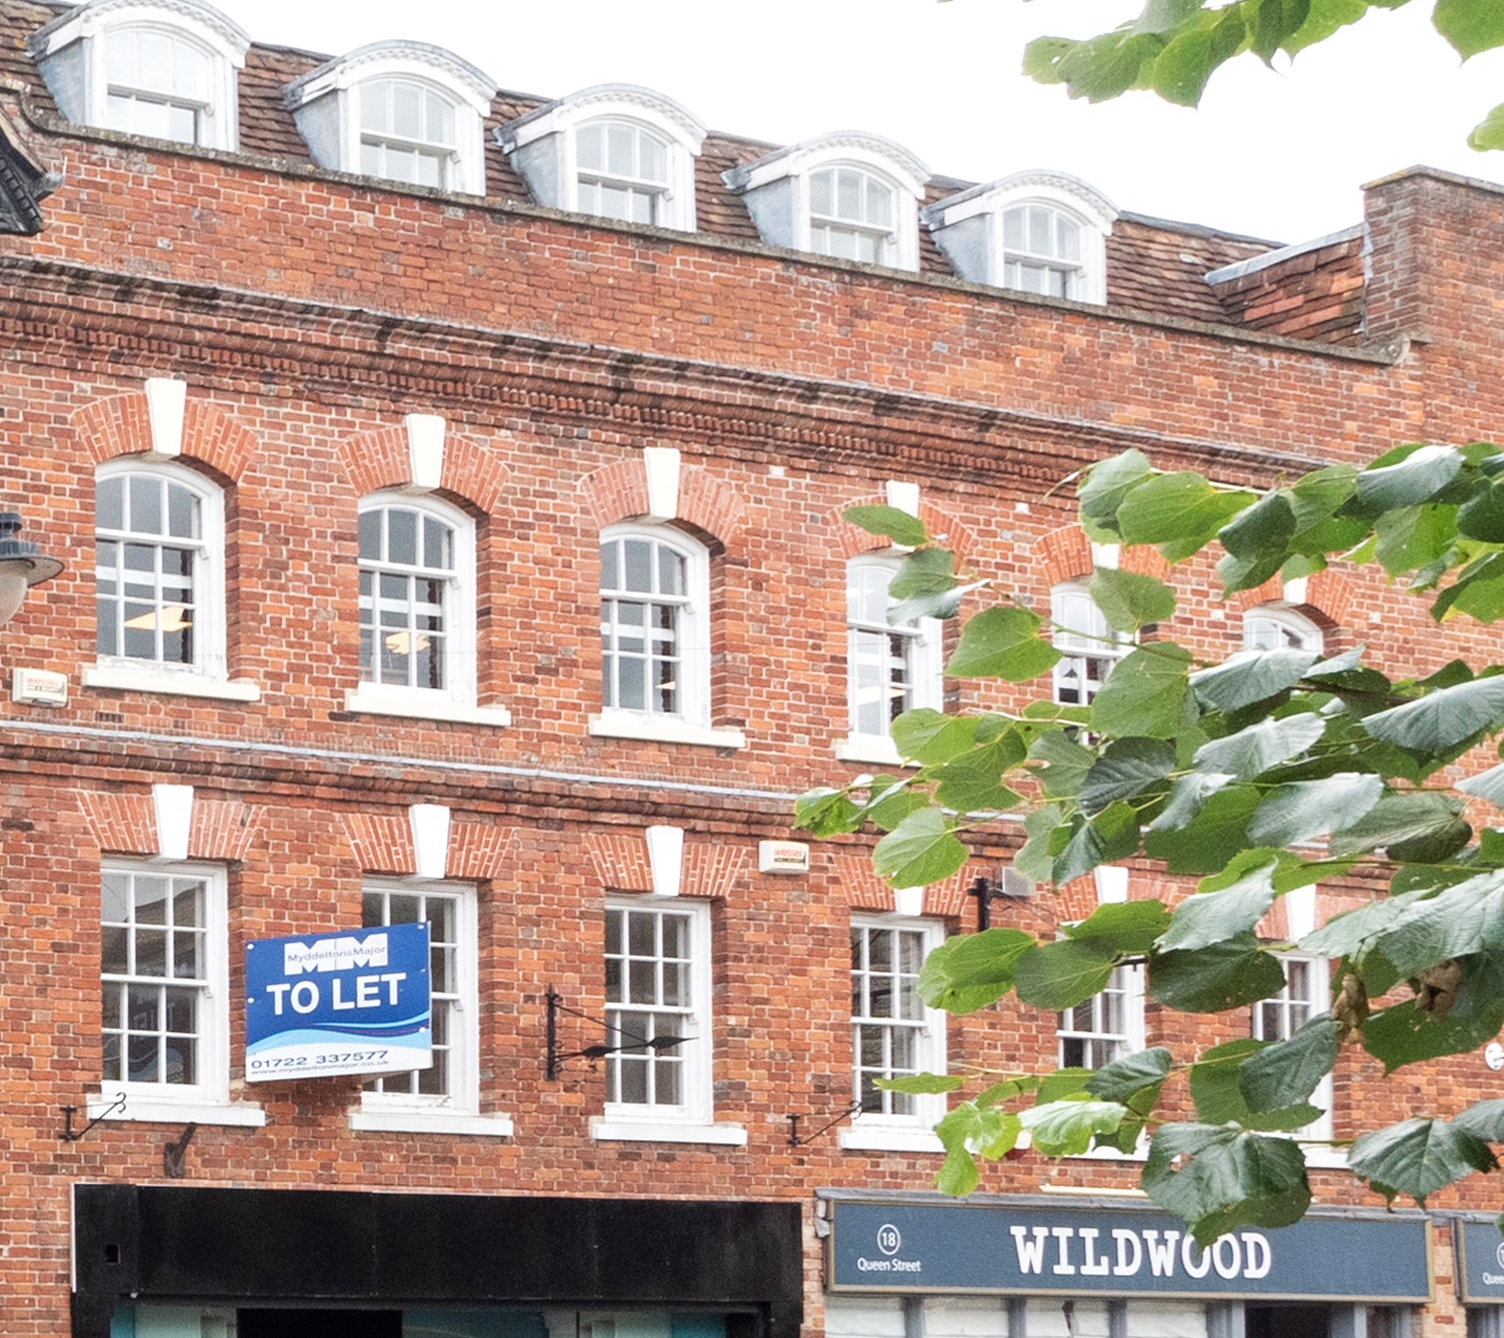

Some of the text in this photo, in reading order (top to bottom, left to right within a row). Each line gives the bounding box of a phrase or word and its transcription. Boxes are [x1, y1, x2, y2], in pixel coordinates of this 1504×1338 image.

[266, 972, 407, 1016] TO LET
[251, 1050, 388, 1069] 01722 337577
[881, 1231, 896, 1247] 18
[1010, 1225, 1272, 1279] WILDWOOD
[857, 1257, 922, 1274] Queen Street
